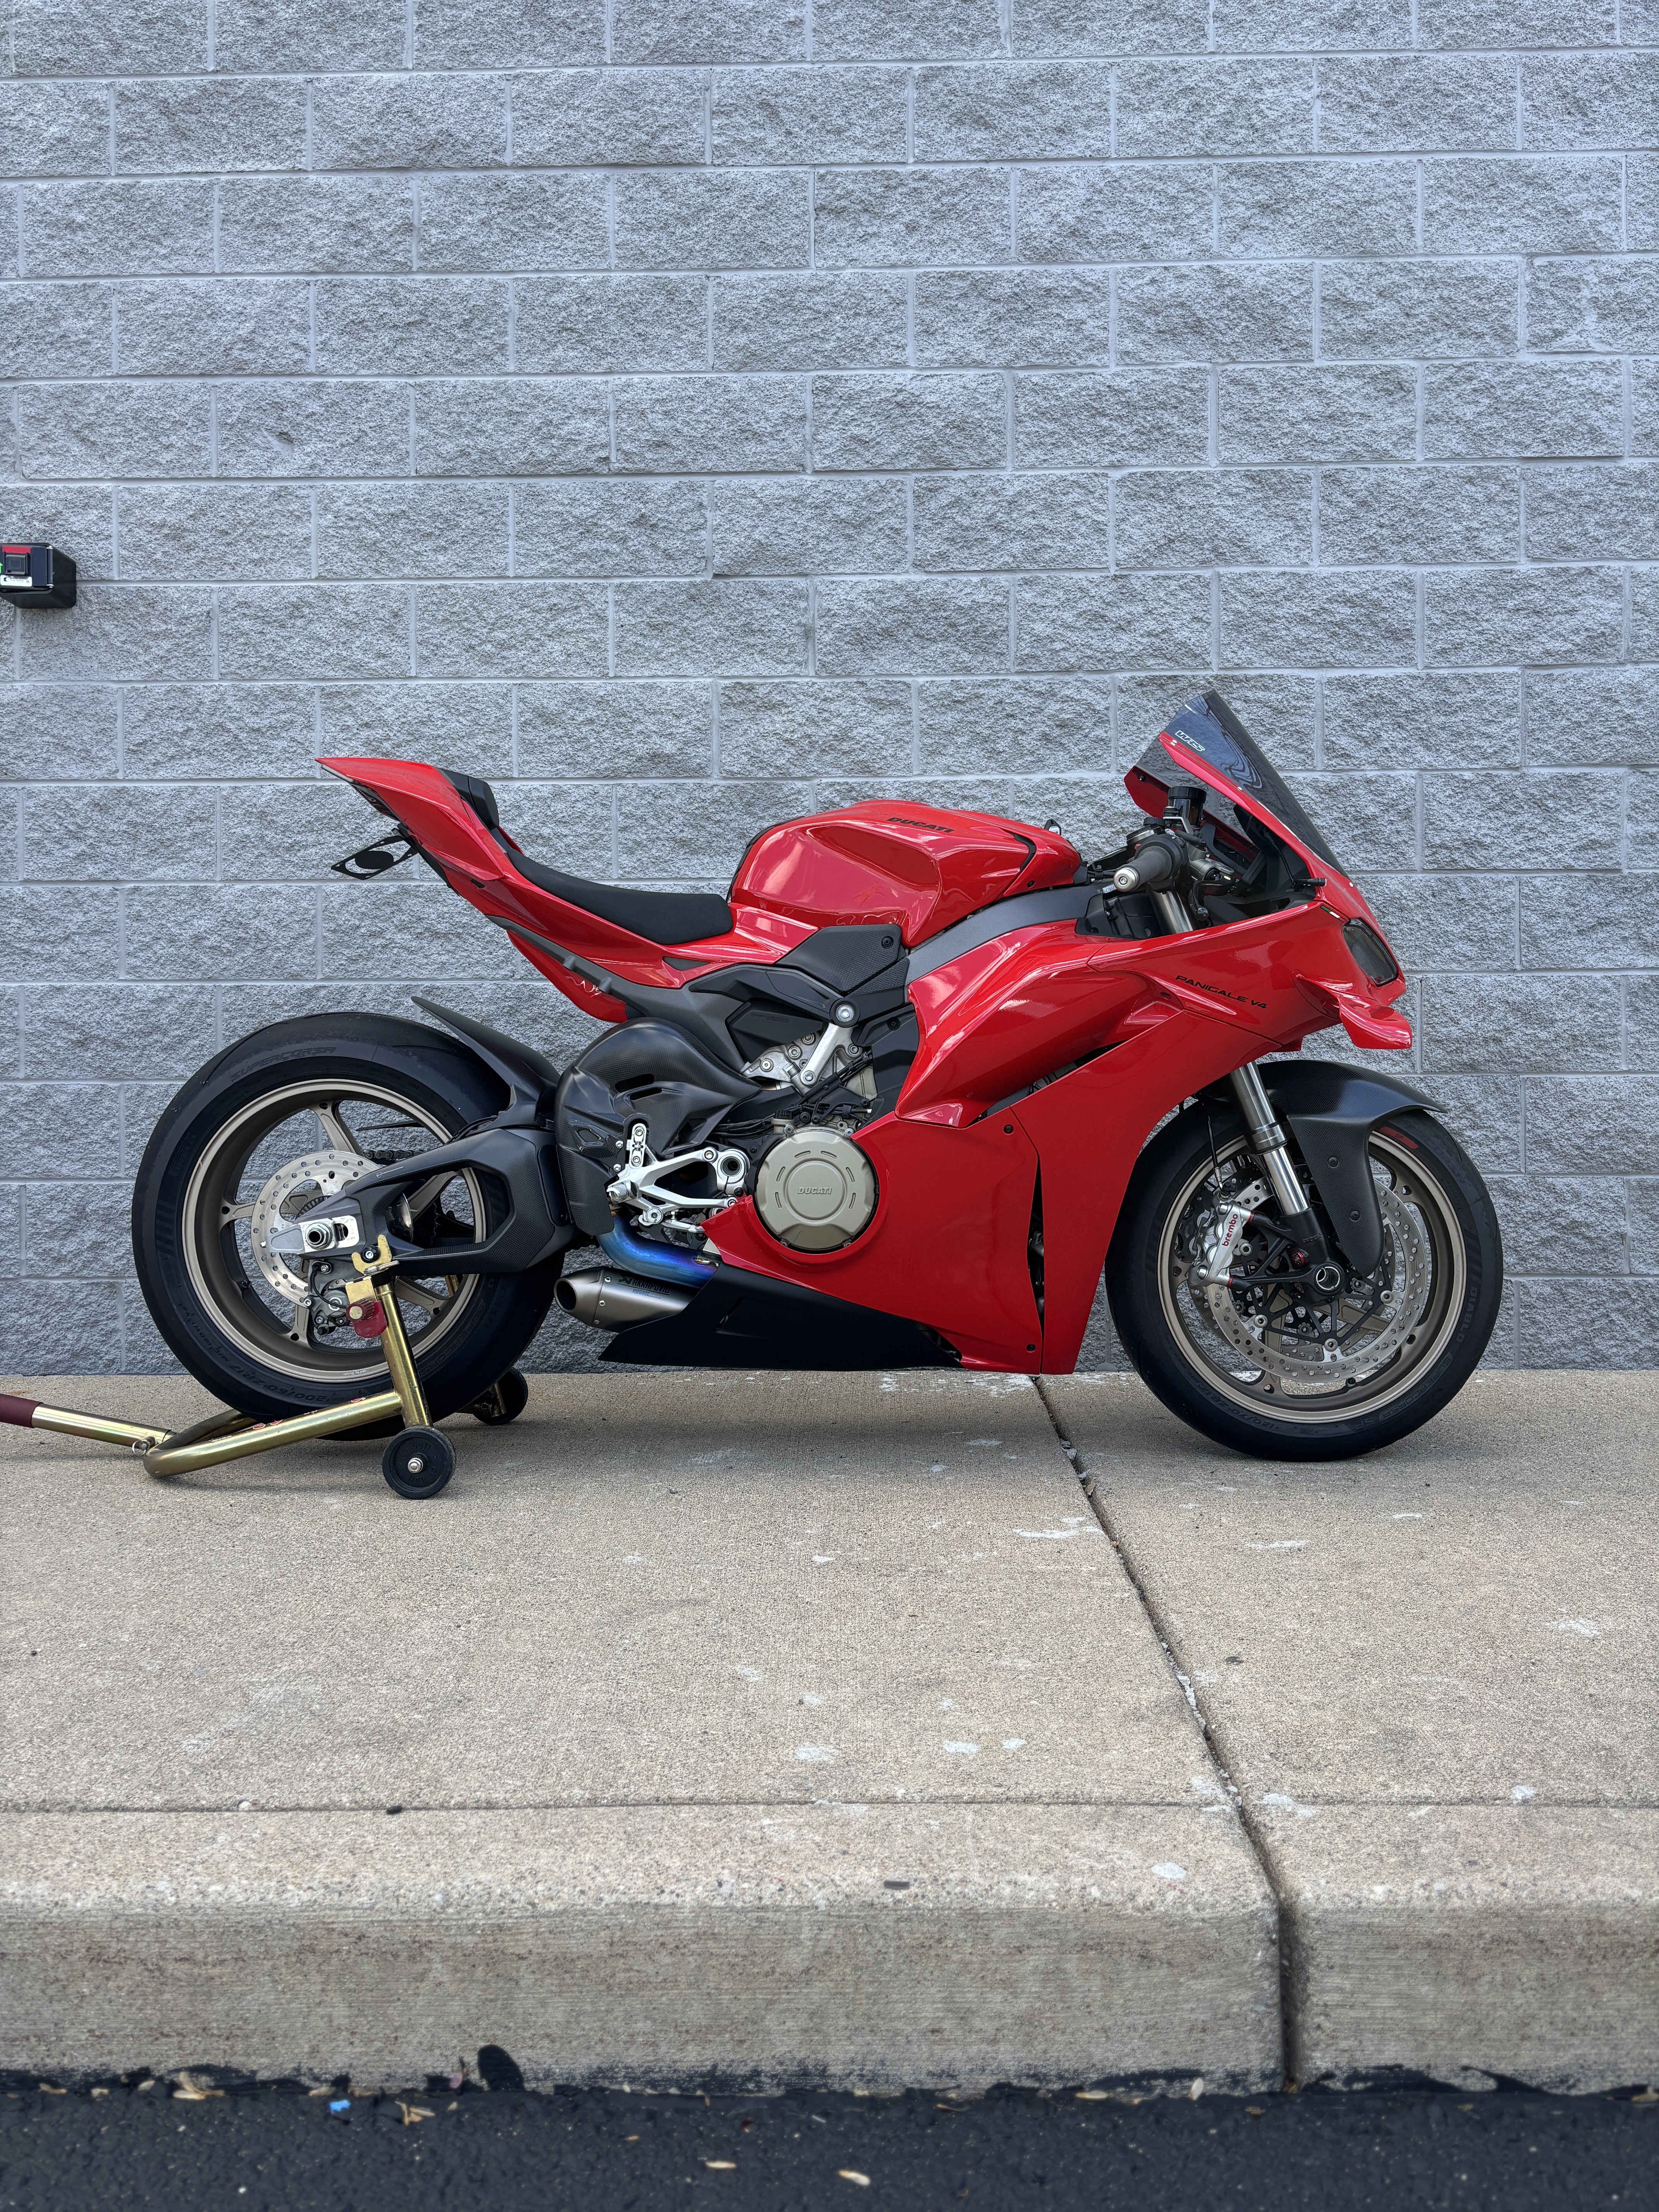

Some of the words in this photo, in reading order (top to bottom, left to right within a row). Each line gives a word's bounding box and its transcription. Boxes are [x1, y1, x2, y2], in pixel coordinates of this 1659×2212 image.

[1175, 730, 1205, 751] WRS
[886, 817, 954, 833] DUCATI
[1251, 1000, 1267, 1008] V4
[231, 1047, 337, 1082] SUPERCORSA
[1222, 1214, 1238, 1246] brembo
[1457, 1286, 1478, 1343] DIABLO
[421, 1304, 486, 1377] SUPERCORS
[229, 1365, 266, 1385] ZR17
[266, 1385, 326, 1402] 200/60
[1382, 1358, 1451, 1418] SUPERCORSA
[1354, 1418, 1375, 1430] SP
